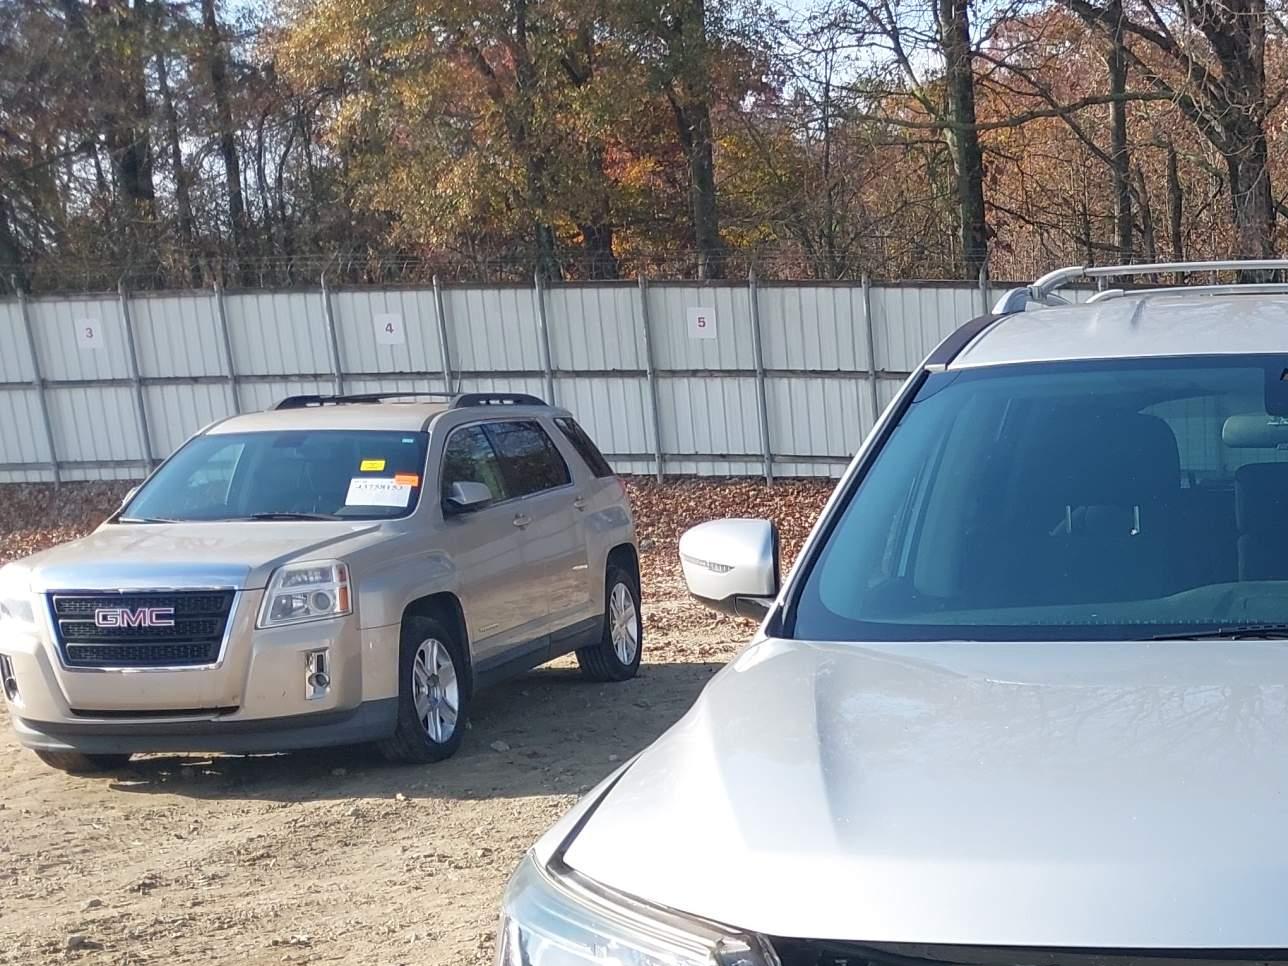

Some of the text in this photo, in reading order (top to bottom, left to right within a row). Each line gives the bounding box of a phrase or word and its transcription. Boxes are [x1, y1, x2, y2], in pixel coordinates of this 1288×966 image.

[385, 322, 394, 334] 4
[697, 316, 706, 328] 5
[85, 327, 94, 338] 3
[95, 607, 175, 628] GMC
